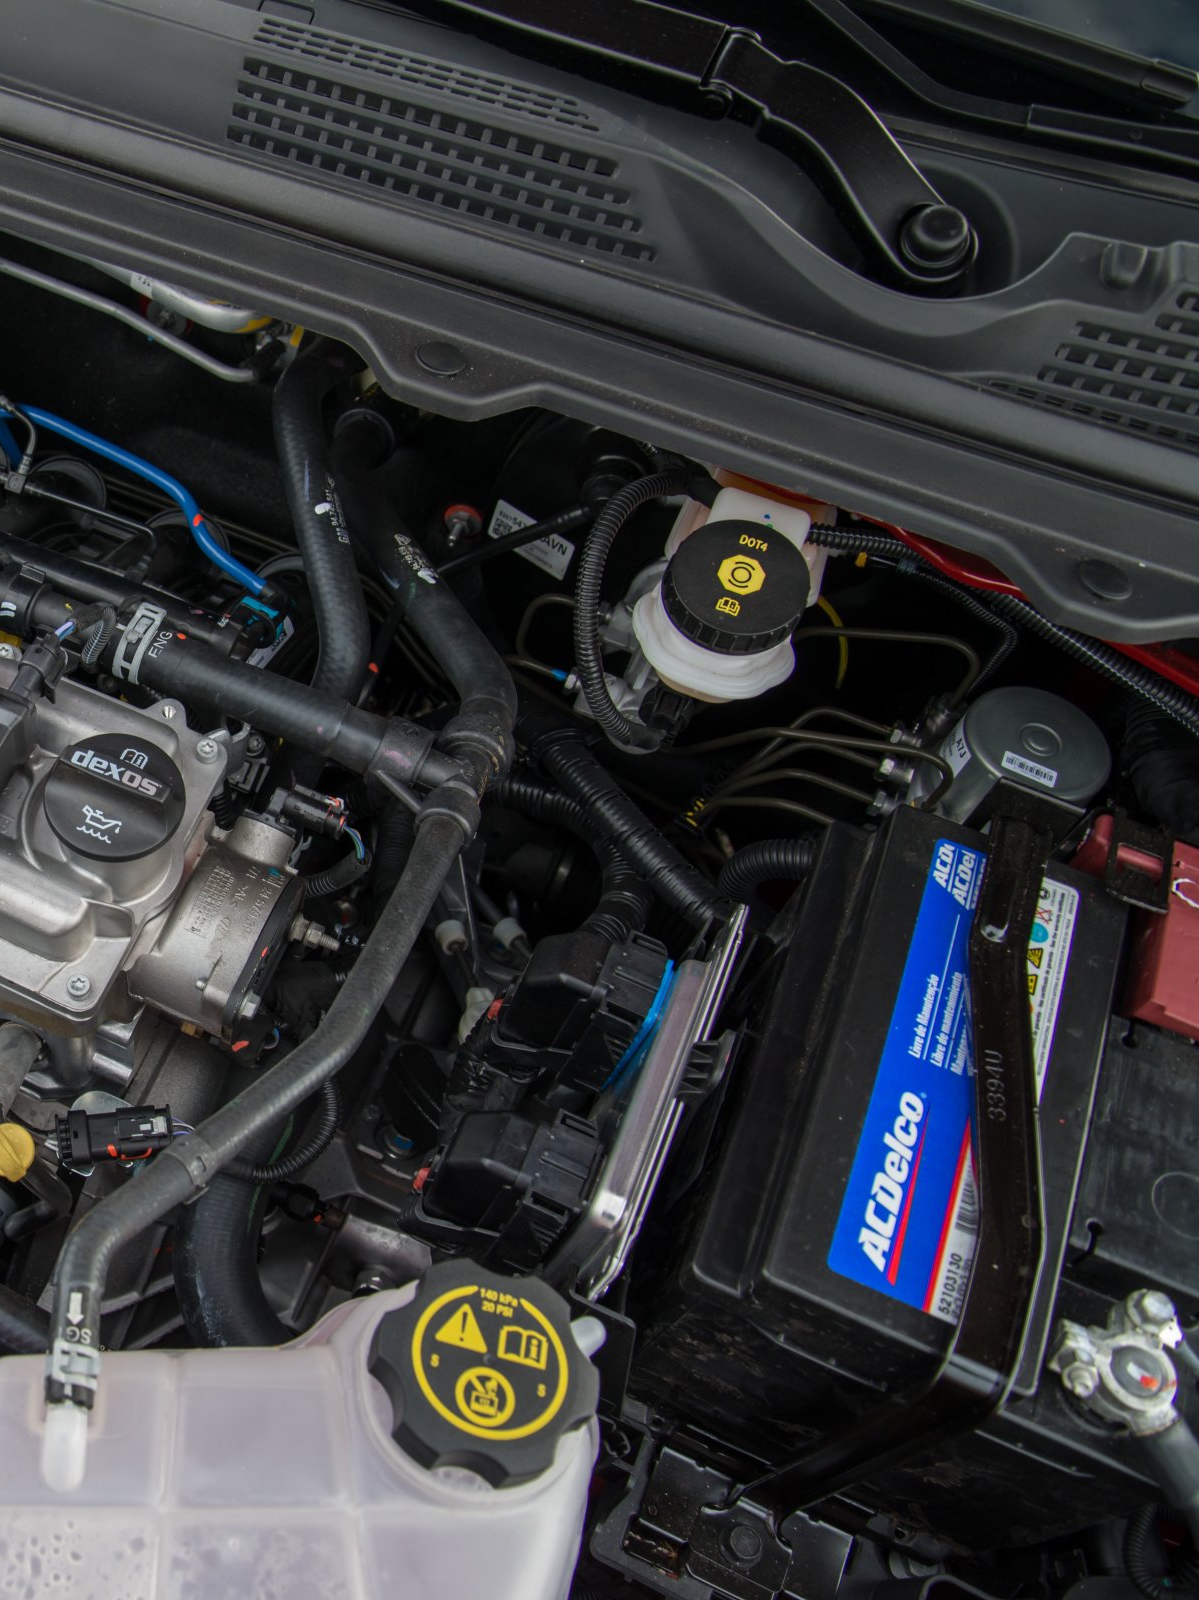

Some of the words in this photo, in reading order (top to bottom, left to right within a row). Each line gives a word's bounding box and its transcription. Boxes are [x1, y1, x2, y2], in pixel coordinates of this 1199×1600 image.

[739, 534, 768, 552] DOT4
[147, 628, 174, 661] ENG
[71, 748, 160, 797] dexos
[938, 970, 963, 1034] mantenimiento
[912, 1023, 928, 1038] de
[934, 1031, 950, 1046] de
[908, 1036, 924, 1058] Livre
[930, 1044, 946, 1067] Libre
[985, 1050, 1004, 1122] 3394U
[859, 1091, 924, 1272] ACDelco
[937, 1252, 963, 1316] 52103130
[479, 1288, 498, 1302] 140
[498, 1293, 519, 1308] kPa
[481, 1302, 496, 1313] 20
[495, 1305, 514, 1318] PSI
